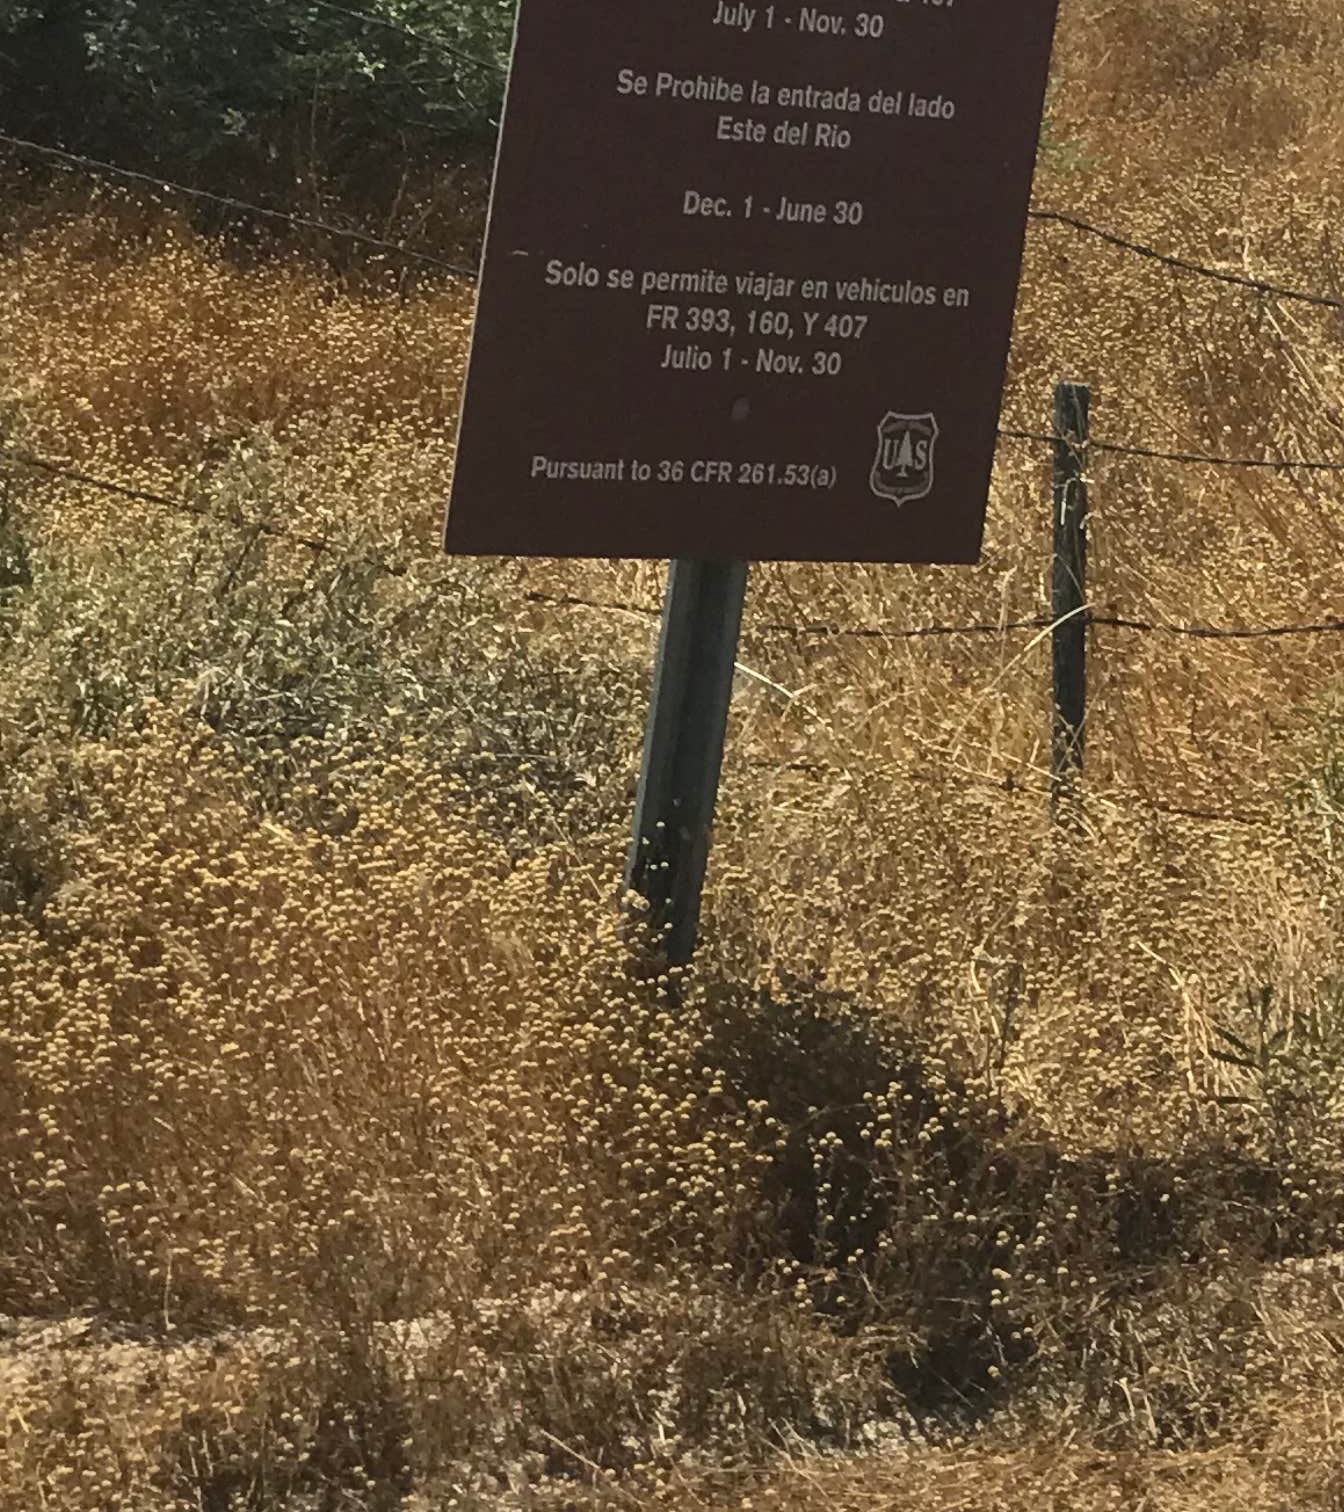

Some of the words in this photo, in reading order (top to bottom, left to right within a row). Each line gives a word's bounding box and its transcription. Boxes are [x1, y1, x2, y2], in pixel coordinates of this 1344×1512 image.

[712, 0, 757, 33] July
[765, 5, 775, 29] 1
[798, 7, 847, 35] Nov.
[854, 12, 885, 38] 30
[616, 68, 649, 96] Se
[655, 71, 744, 103] Prohibe
[750, 79, 771, 105] la
[777, 84, 861, 113] entrada
[867, 89, 903, 115] del
[907, 92, 955, 120] lado
[716, 115, 767, 143] Este
[773, 119, 809, 146] del
[814, 122, 852, 149] Rio
[683, 189, 732, 217] Dec.
[744, 195, 753, 219] 1
[775, 196, 827, 223] June
[832, 200, 863, 225] 30
[544, 259, 600, 287] Solo
[606, 268, 635, 289] se
[640, 268, 729, 295] permite
[735, 271, 796, 302] viajar
[801, 279, 829, 300] en
[835, 277, 937, 305] vehiculos
[943, 287, 969, 307] en
[646, 303, 679, 329] FR
[685, 306, 736, 337] 393,
[747, 309, 794, 340] 160,
[803, 311, 820, 337] Y
[823, 313, 868, 339] 407
[660, 343, 713, 371] Julio
[722, 347, 732, 371] 1
[755, 347, 803, 374] Nov.
[811, 351, 842, 375] 30
[530, 455, 625, 481] Pursuant
[631, 459, 651, 481] to
[657, 459, 685, 482] 36
[690, 460, 733, 483] CFR
[737, 462, 837, 489] 261.53(a)
